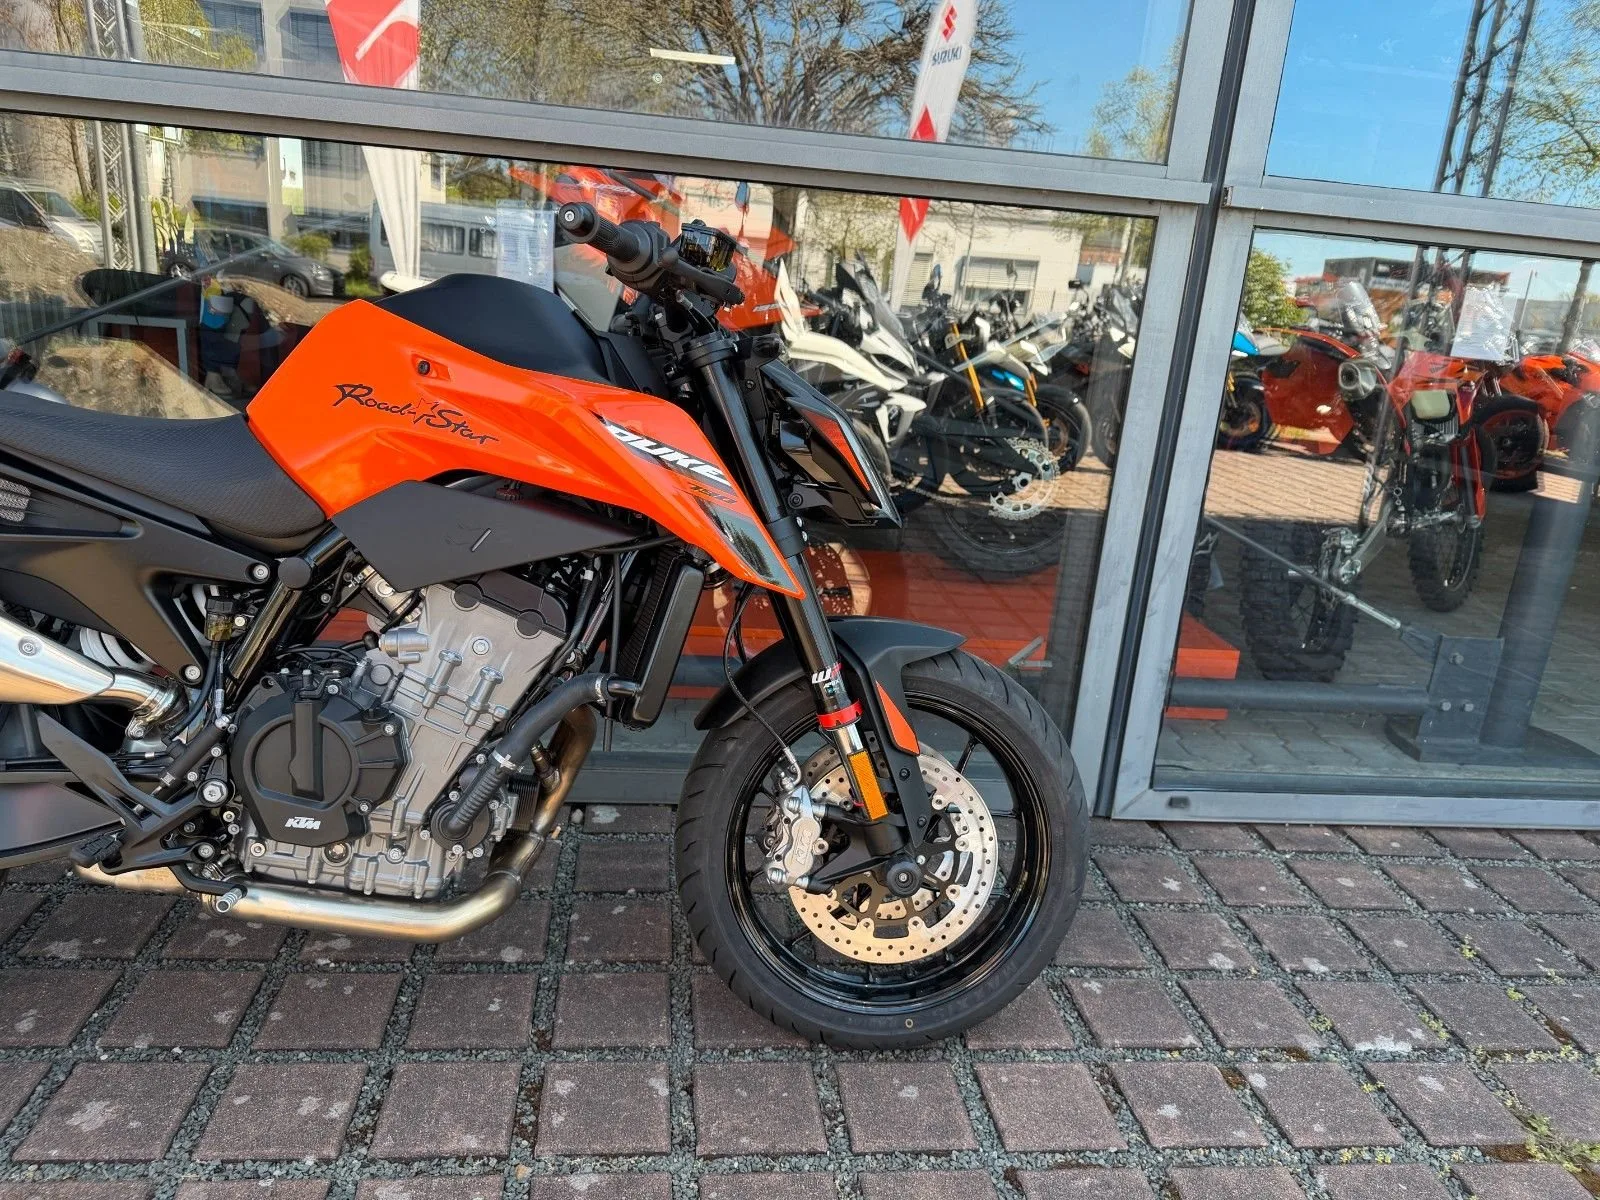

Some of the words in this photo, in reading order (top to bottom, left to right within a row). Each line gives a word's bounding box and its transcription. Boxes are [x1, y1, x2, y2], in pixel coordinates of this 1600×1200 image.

[932, 45, 963, 66] SUZUKI
[605, 424, 733, 487] DUKE
[284, 816, 322, 830] KTM
